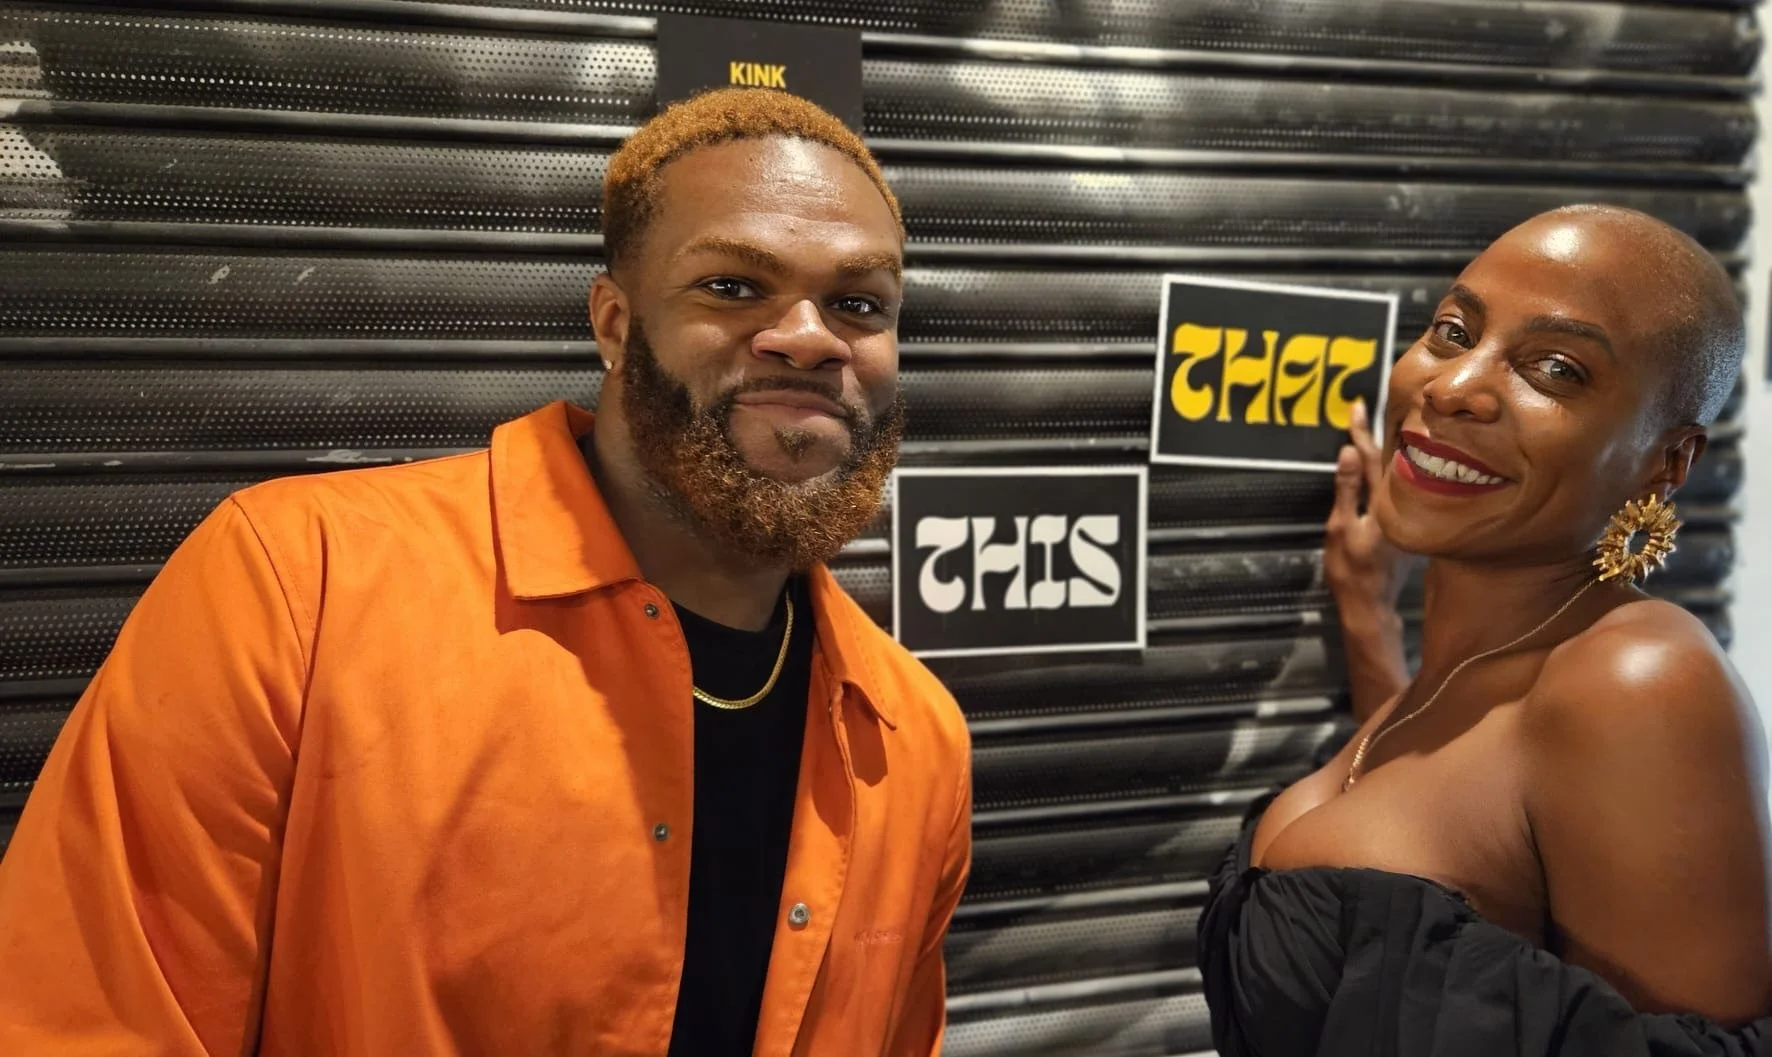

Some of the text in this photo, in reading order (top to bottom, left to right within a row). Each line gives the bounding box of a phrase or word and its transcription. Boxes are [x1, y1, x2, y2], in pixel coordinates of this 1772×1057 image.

[730, 62, 786, 88] KINK
[1171, 323, 1377, 430] THAT
[916, 514, 1121, 613] THIS
